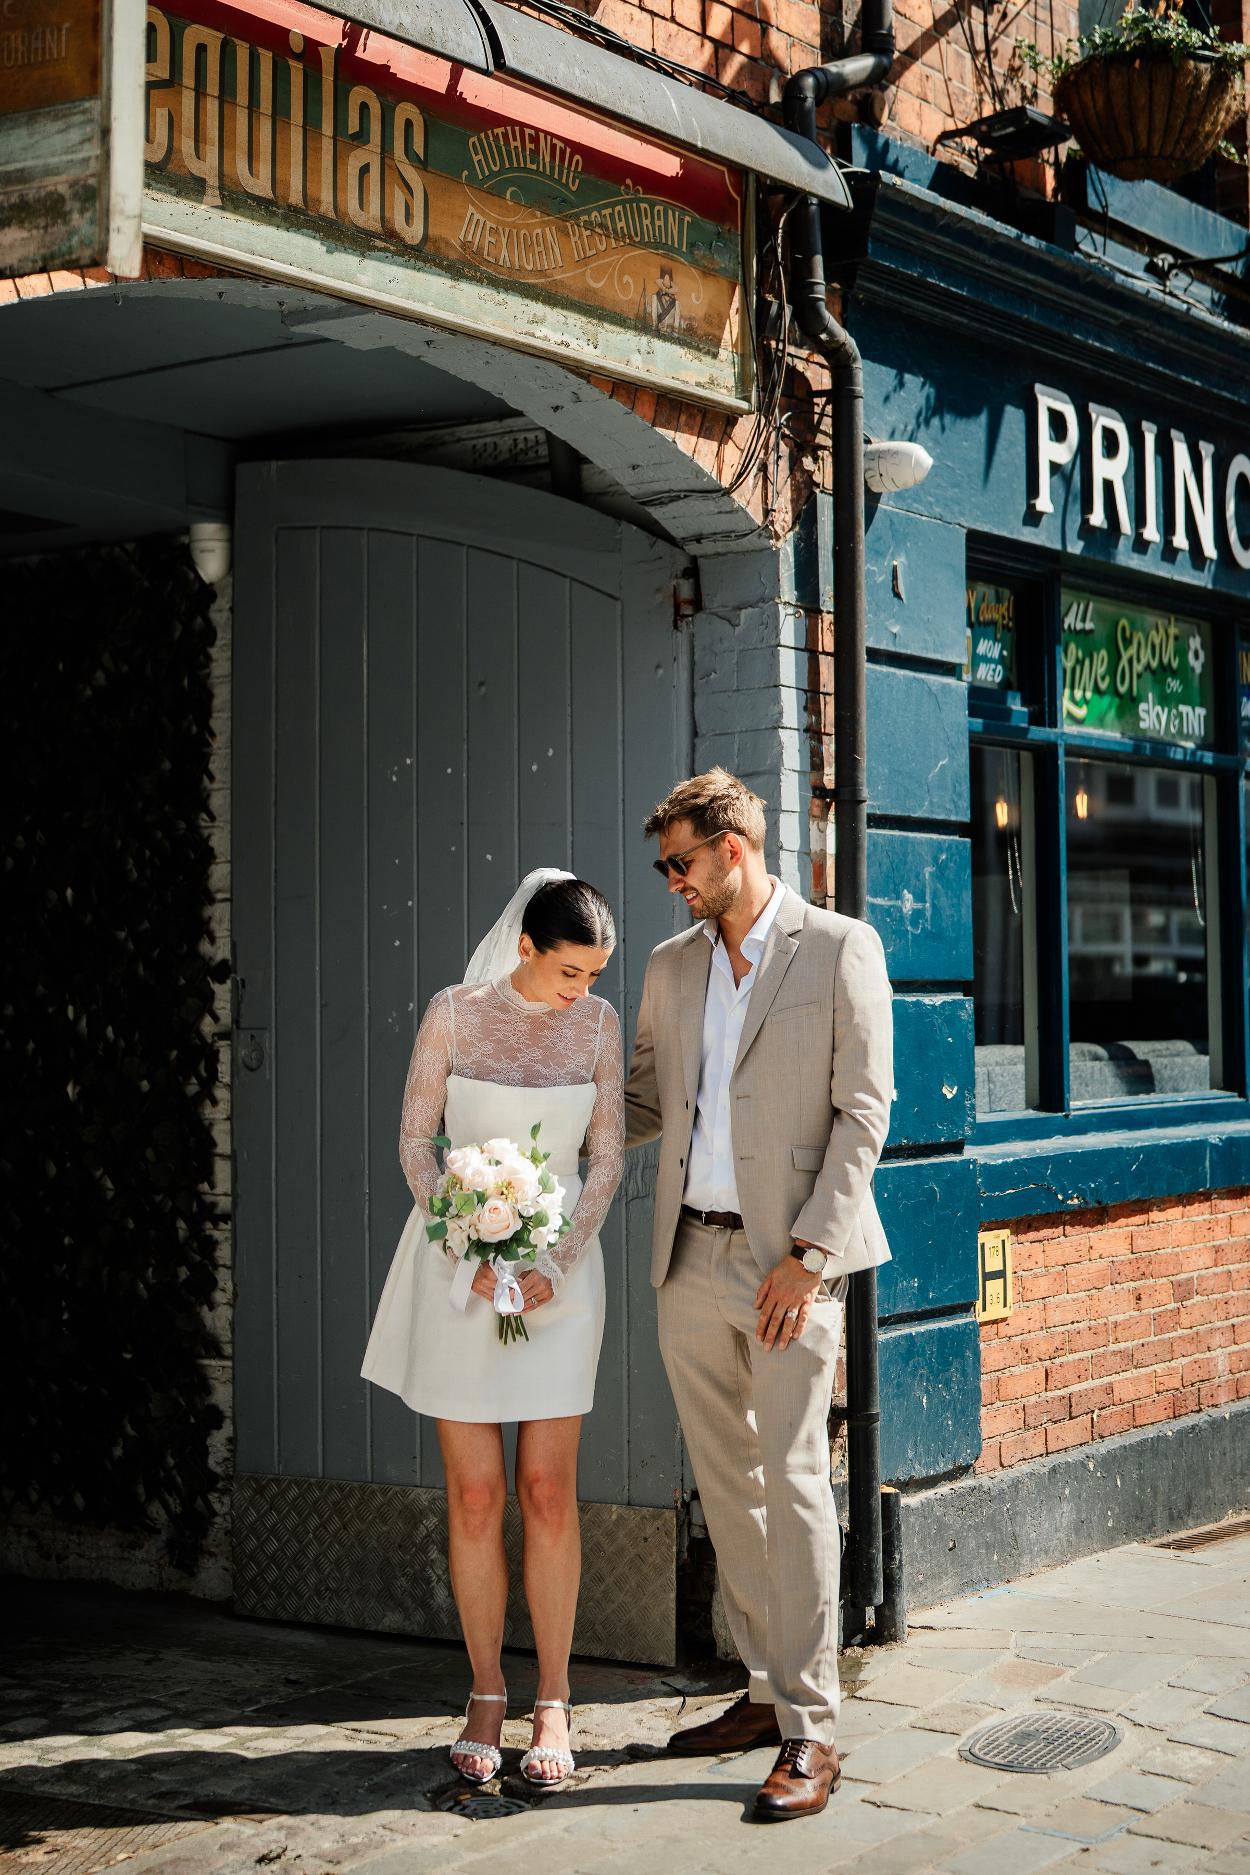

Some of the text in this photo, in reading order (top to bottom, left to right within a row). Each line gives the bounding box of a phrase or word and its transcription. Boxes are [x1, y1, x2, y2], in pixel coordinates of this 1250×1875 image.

[467, 126, 583, 192] AUTHENTIC
[458, 203, 693, 271] MEXICAN RESTAURANT
[1064, 601, 1095, 631] ALL
[976, 662, 1003, 683] WED
[1062, 615, 1179, 719] Live Sport
[1166, 677, 1183, 694] on
[1178, 704, 1206, 736] TNT
